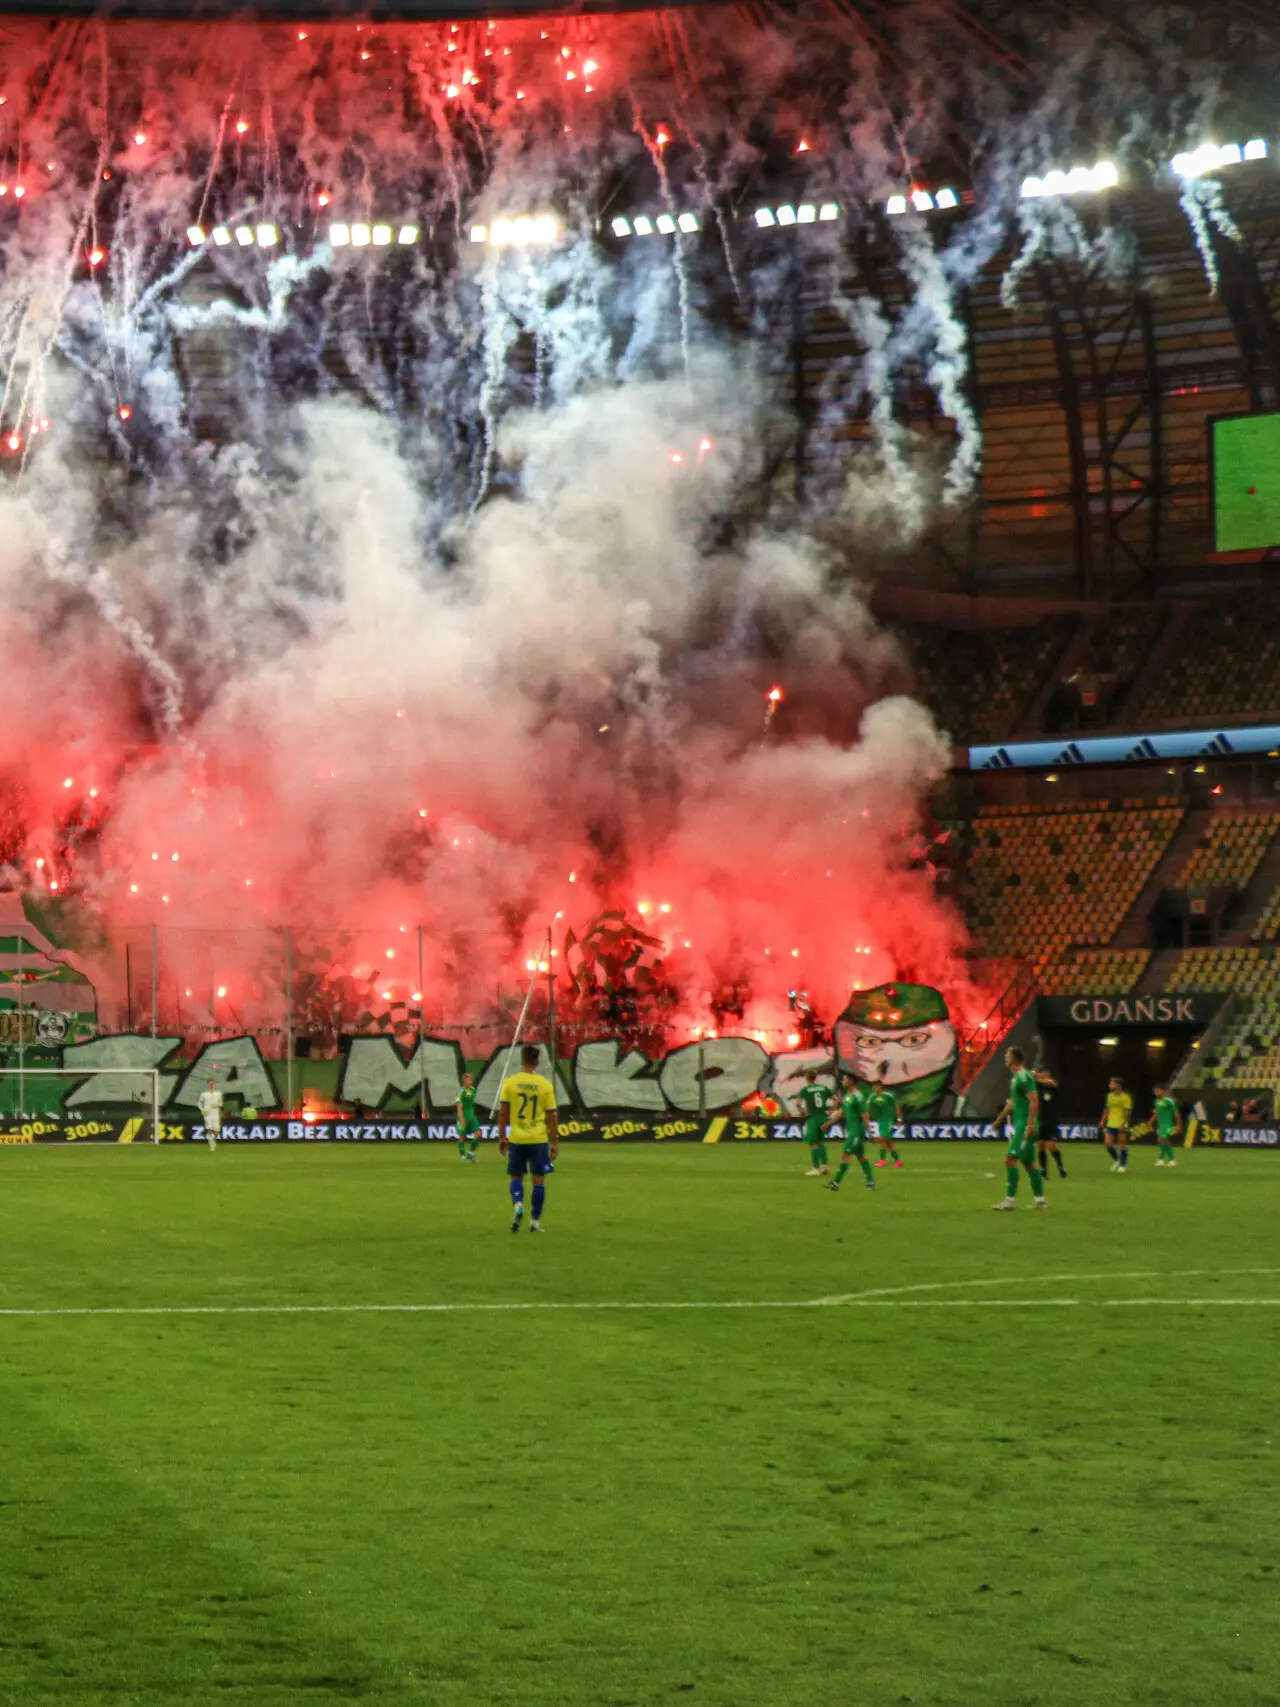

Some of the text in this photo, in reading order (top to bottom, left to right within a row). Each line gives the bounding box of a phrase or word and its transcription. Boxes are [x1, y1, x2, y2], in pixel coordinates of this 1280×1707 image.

[1070, 994, 1195, 1022] GDAŃSK
[61, 1033, 285, 1110] ZA
[517, 1092, 538, 1121] 21
[813, 1092, 823, 1108] 6
[191, 1125, 280, 1140] ZKŁAD
[287, 1121, 329, 1140] BEZ
[335, 1124, 421, 1140] RYZYKA
[427, 1124, 459, 1140] NA
[733, 1121, 767, 1139] 3x
[865, 1120, 906, 1139] BZ
[910, 1124, 999, 1140] RYZYKA
[1223, 1127, 1278, 1144] ZAKŁAD
